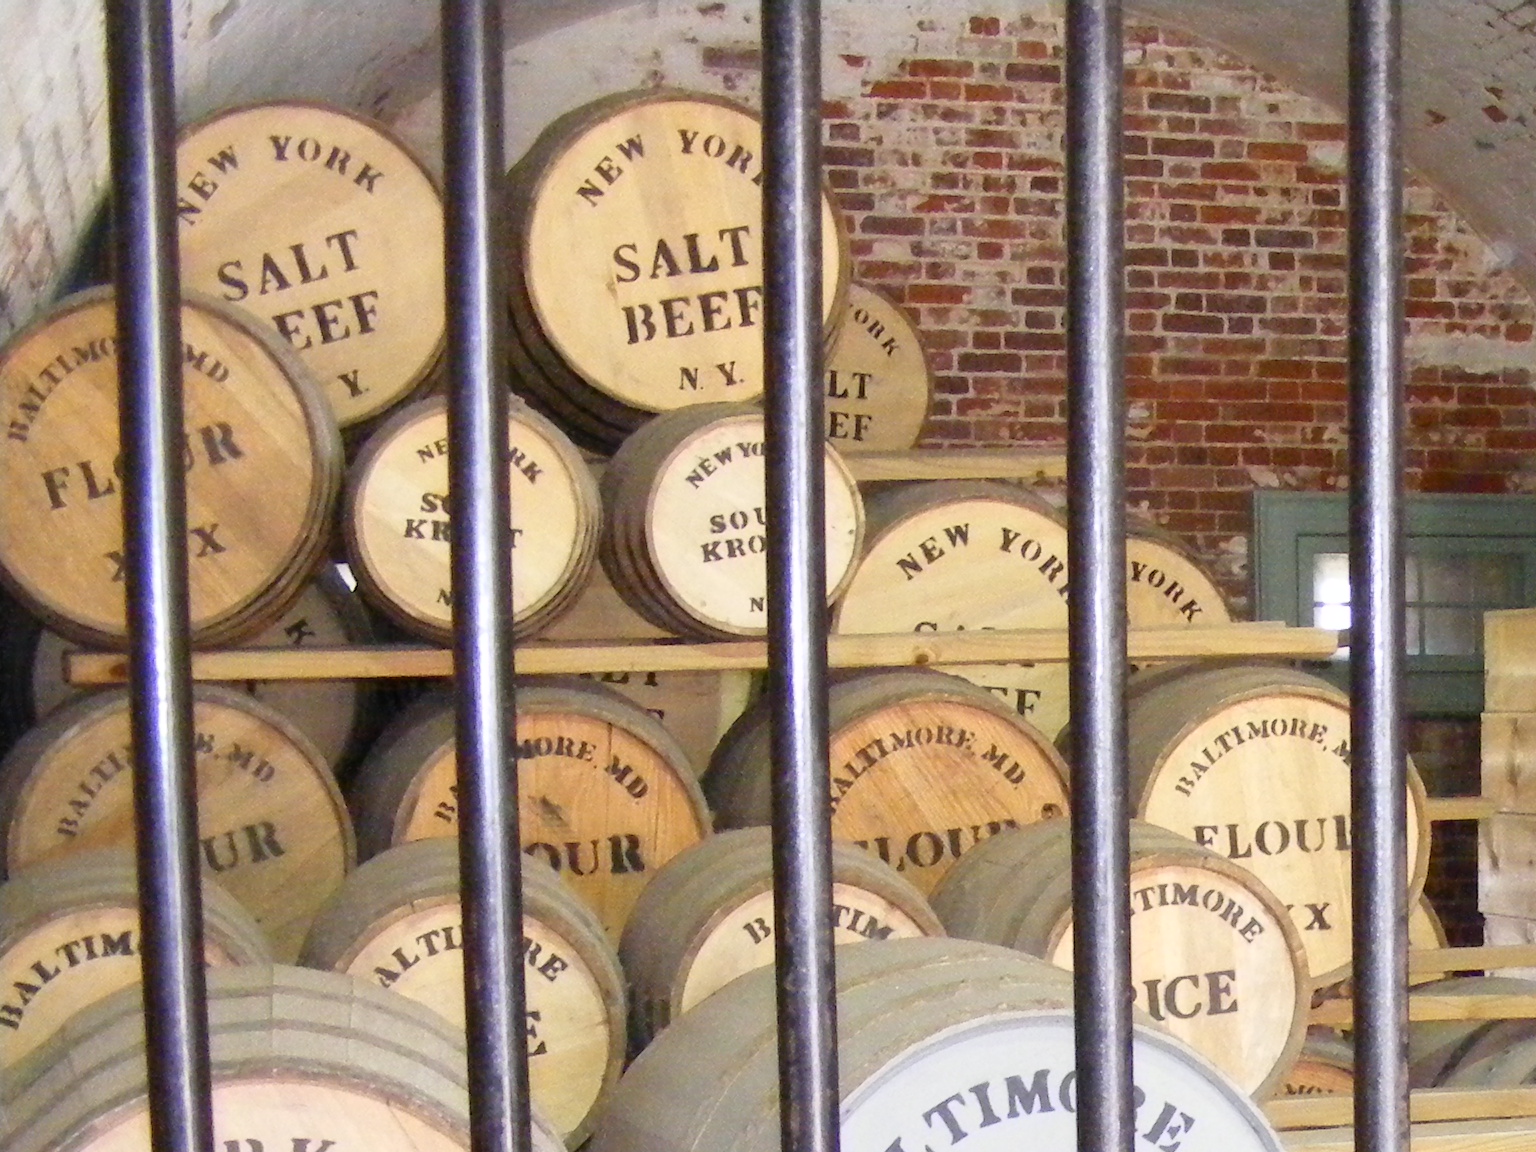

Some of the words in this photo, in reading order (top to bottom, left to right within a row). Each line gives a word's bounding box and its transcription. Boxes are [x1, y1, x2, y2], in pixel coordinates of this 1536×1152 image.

[178, 145, 239, 226] NEW
[269, 135, 385, 194] YORK
[575, 134, 645, 207] NEW
[216, 229, 361, 302] SALT
[612, 225, 750, 283] SALT
[272, 291, 380, 352] EEF
[621, 285, 763, 345] BEEF
[848, 303, 900, 358] ORK
[7, 337, 118, 442] BALTIMO
[828, 371, 873, 400] LT
[829, 411, 873, 442] EF
[41, 420, 244, 511] FLR
[416, 437, 449, 464] NE
[509, 446, 544, 485] RK
[685, 442, 733, 489] NEW
[741, 440, 766, 458] YO
[404, 518, 523, 548] KRT
[700, 533, 767, 564] KRO
[709, 508, 767, 534] SOU
[896, 522, 971, 582] NEW
[1130, 560, 1202, 623] YORK
[522, 834, 646, 876] OUR
[1130, 882, 1265, 943] TIMORE
[0, 930, 141, 1030] BALTIM
[373, 925, 568, 989] ALTIRE
[1130, 970, 1238, 1022] ICE
